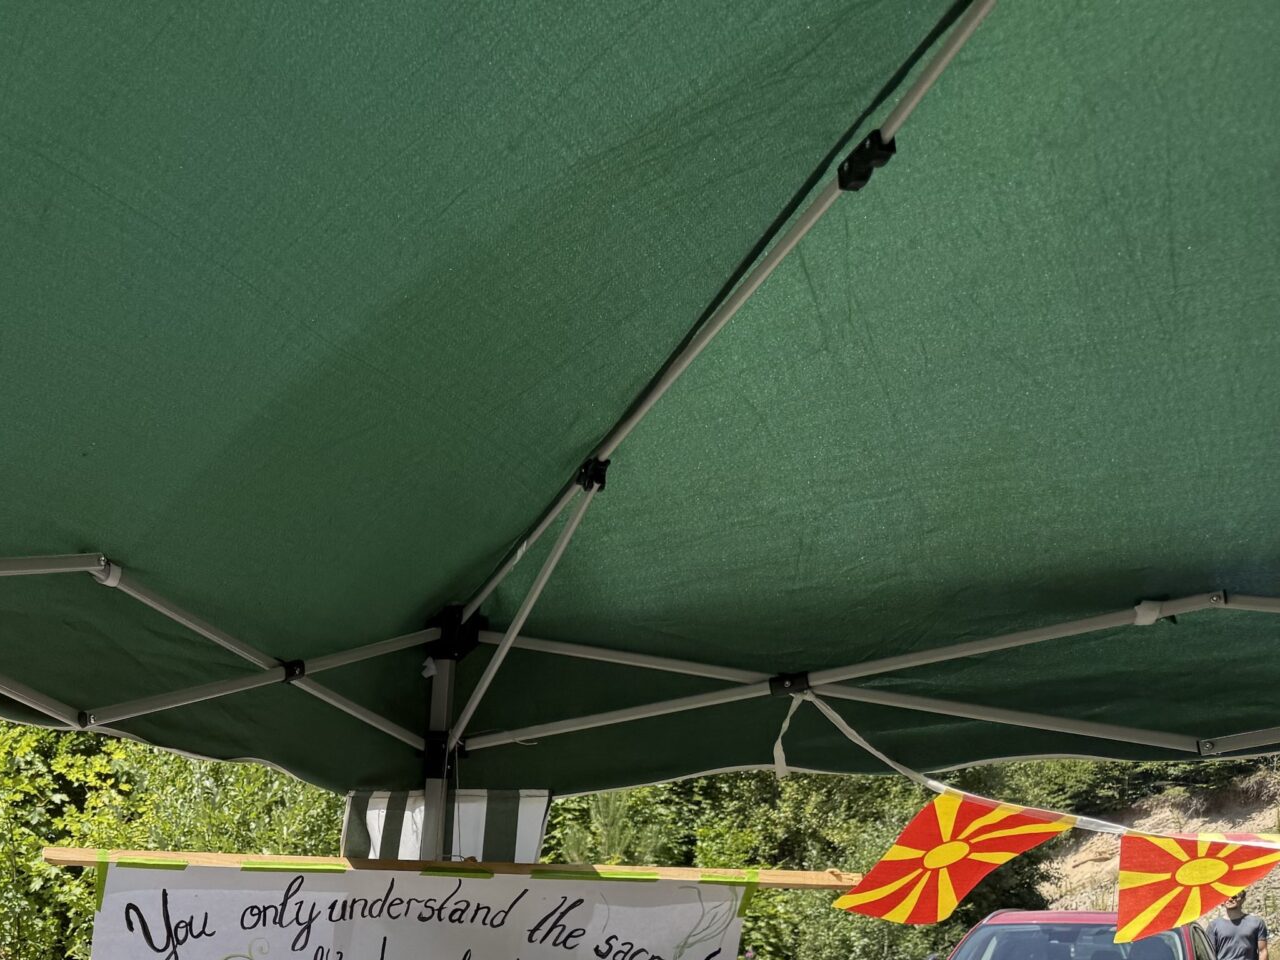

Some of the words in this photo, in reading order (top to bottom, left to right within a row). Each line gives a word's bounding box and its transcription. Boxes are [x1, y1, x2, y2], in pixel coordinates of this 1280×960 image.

[240, 875, 321, 951] only
[327, 877, 529, 928] understand
[527, 896, 587, 950] the
